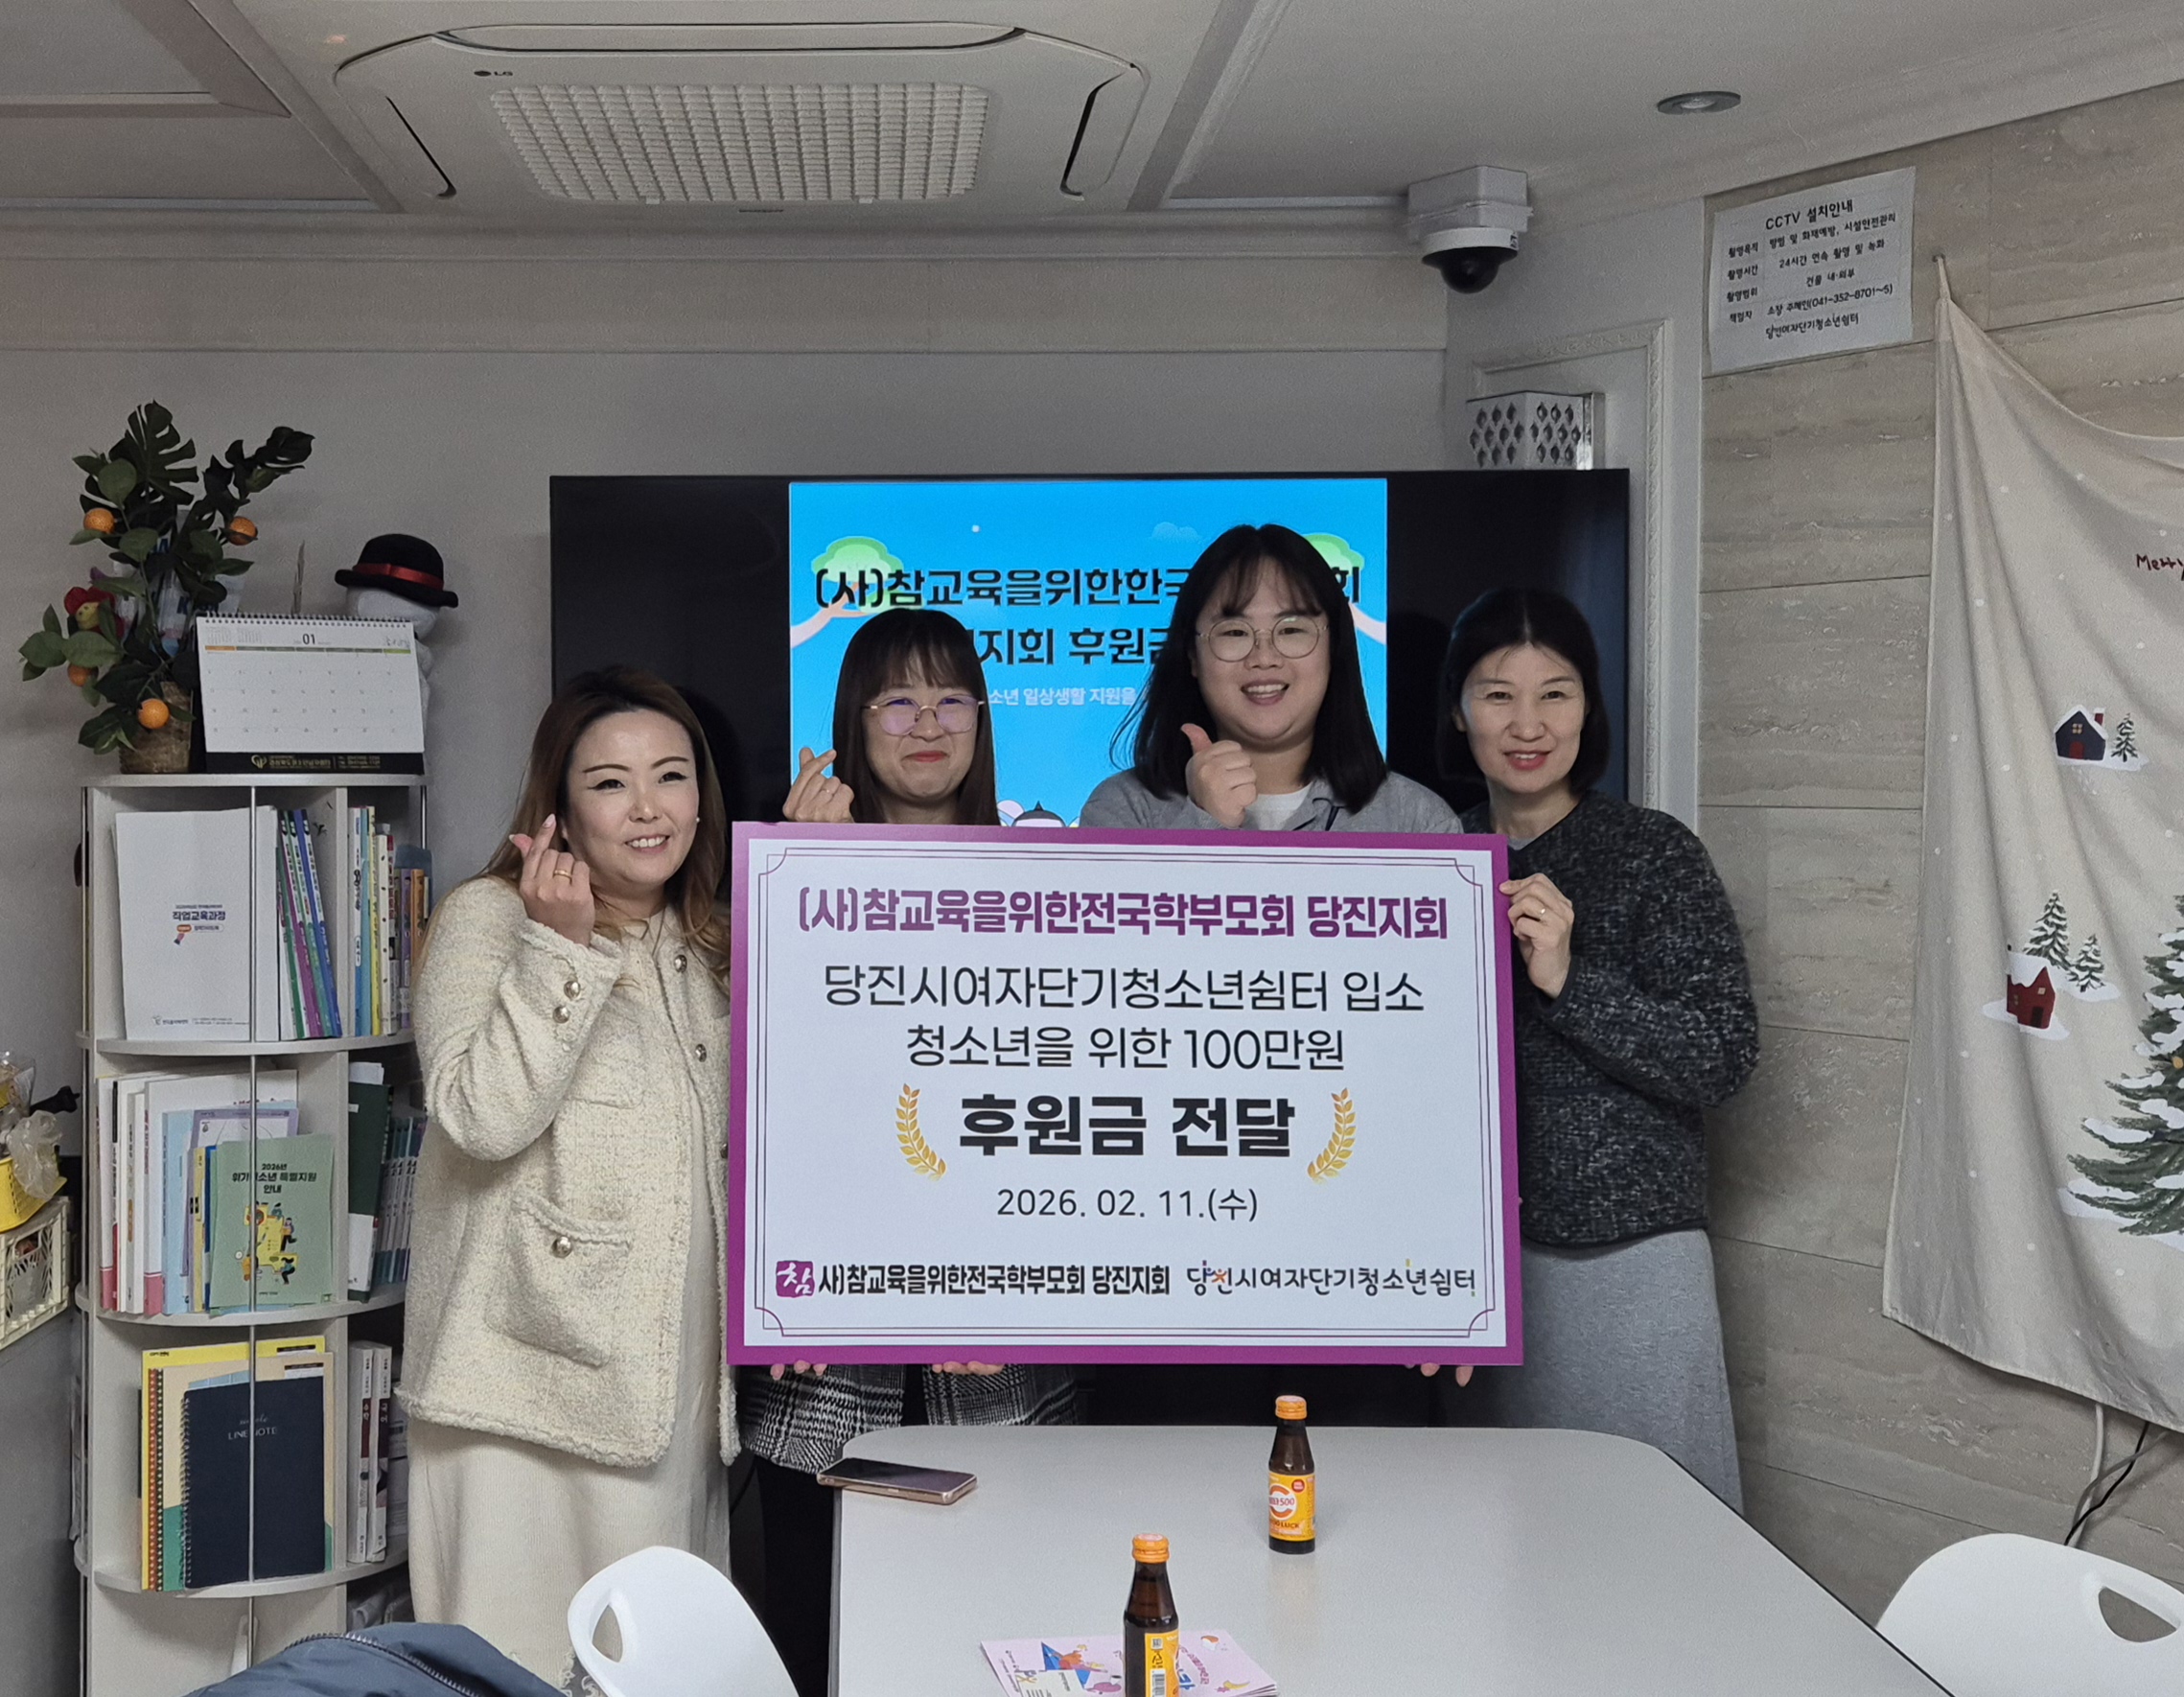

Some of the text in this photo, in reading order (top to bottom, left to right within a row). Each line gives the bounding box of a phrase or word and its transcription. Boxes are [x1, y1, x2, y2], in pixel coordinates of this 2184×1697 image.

[1766, 199, 1853, 230] CCTV 설치안내
[1845, 213, 1896, 231] 시설안전관리
[1779, 254, 1807, 268] 24시간
[302, 633, 315, 644] 01
[966, 628, 1054, 664] 지회
[1023, 687, 1085, 706] 일상생활
[1089, 686, 1136, 706] 지원을
[800, 887, 1448, 939] (사)참교육을위한전국학부모회 당진지회
[825, 965, 1425, 1011] 당진시여자단기청소년쉼터 입소
[907, 1024, 1344, 1070] 청소년을 위한 100만원
[960, 1094, 1296, 1157] 후원금 전달
[232, 1173, 277, 1182] 위기소년
[264, 1184, 282, 1194] 안내
[997, 1189, 1258, 1221] 2026. 02. 11.(수)
[819, 1265, 1170, 1294] 사)참교육을위한전국학부모회 당진지회
[1187, 1259, 1475, 1297] 당진시여자단기청소년쉼터
